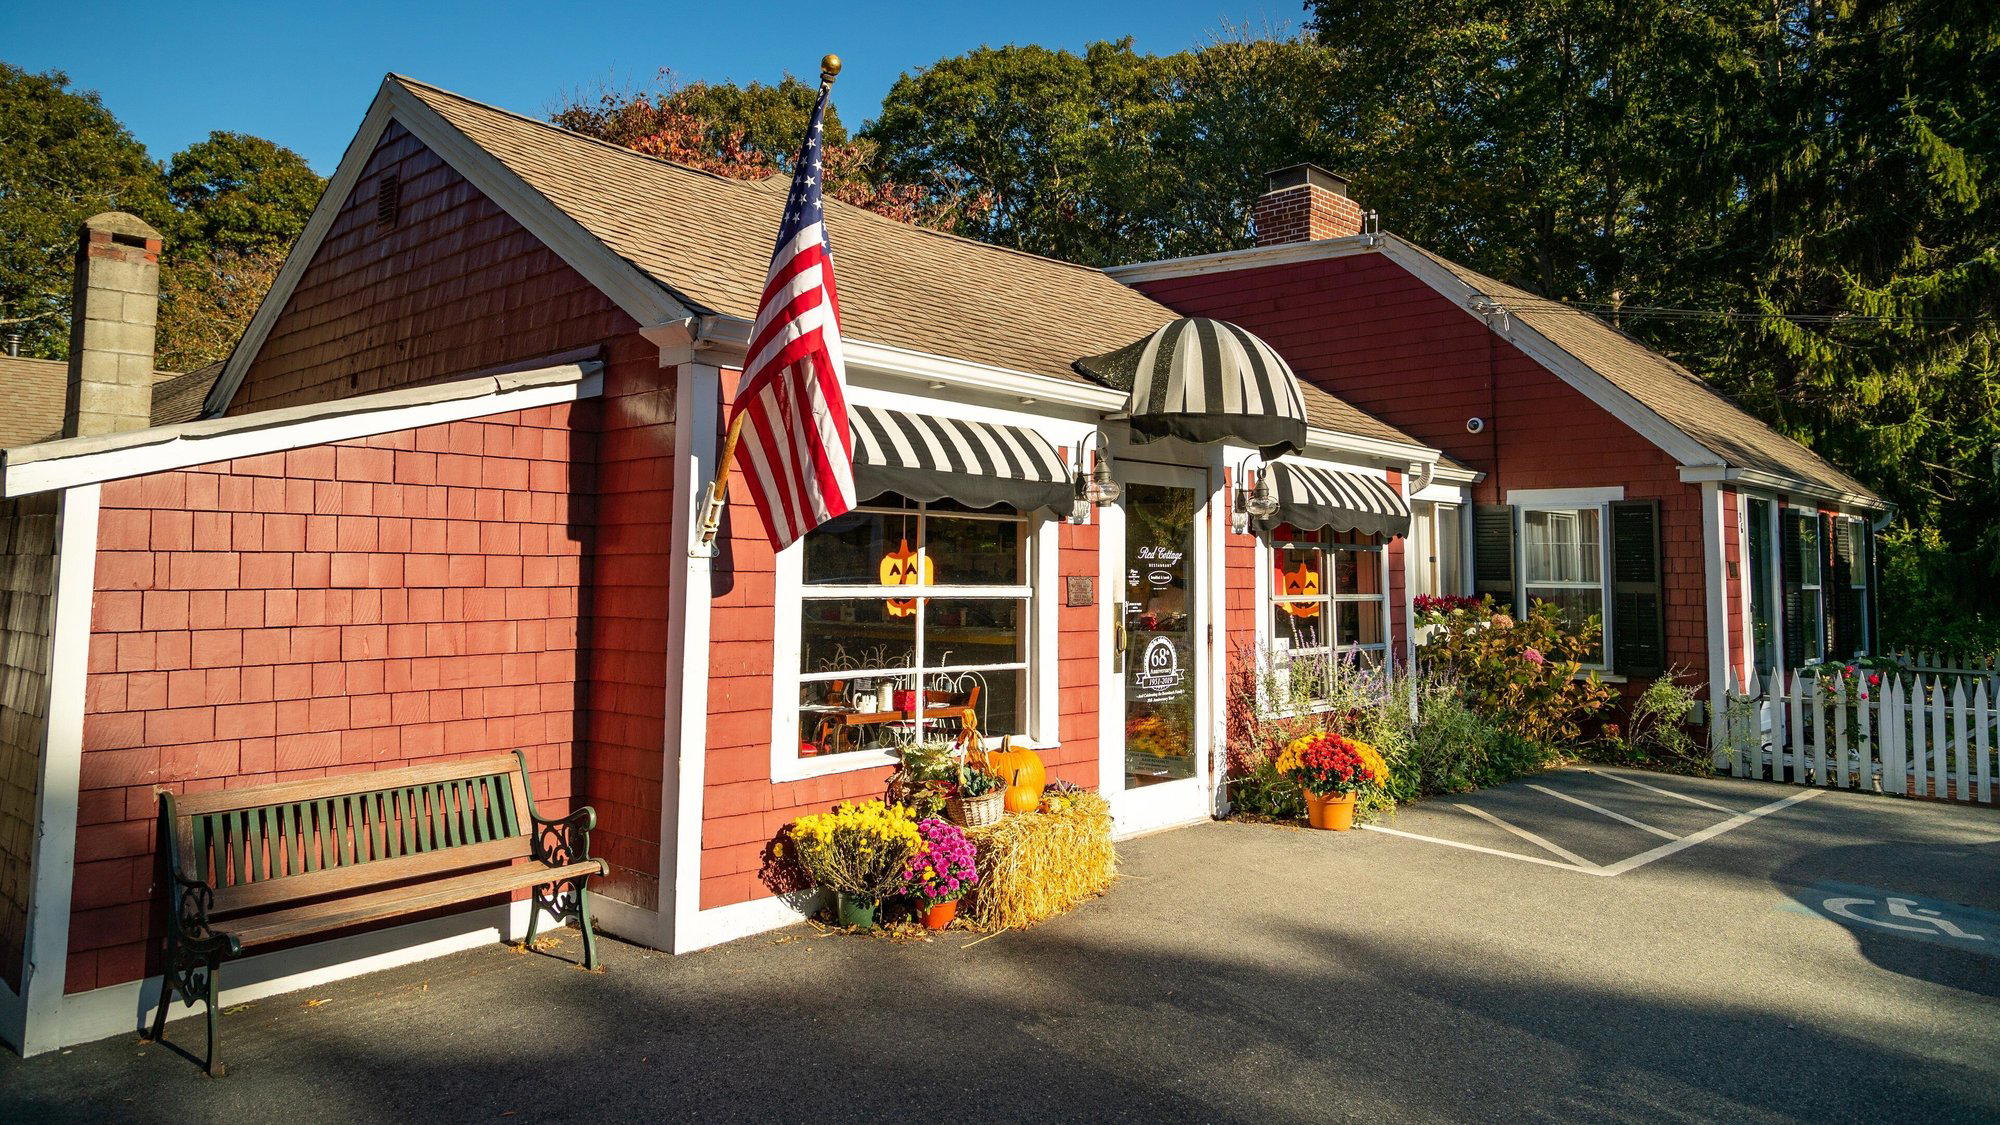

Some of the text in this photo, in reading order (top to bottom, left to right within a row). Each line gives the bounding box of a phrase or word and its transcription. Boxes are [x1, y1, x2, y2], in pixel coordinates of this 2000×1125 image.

[1138, 546, 1183, 566] Red Cottage
[1149, 677, 1173, 686] 1951-2019
